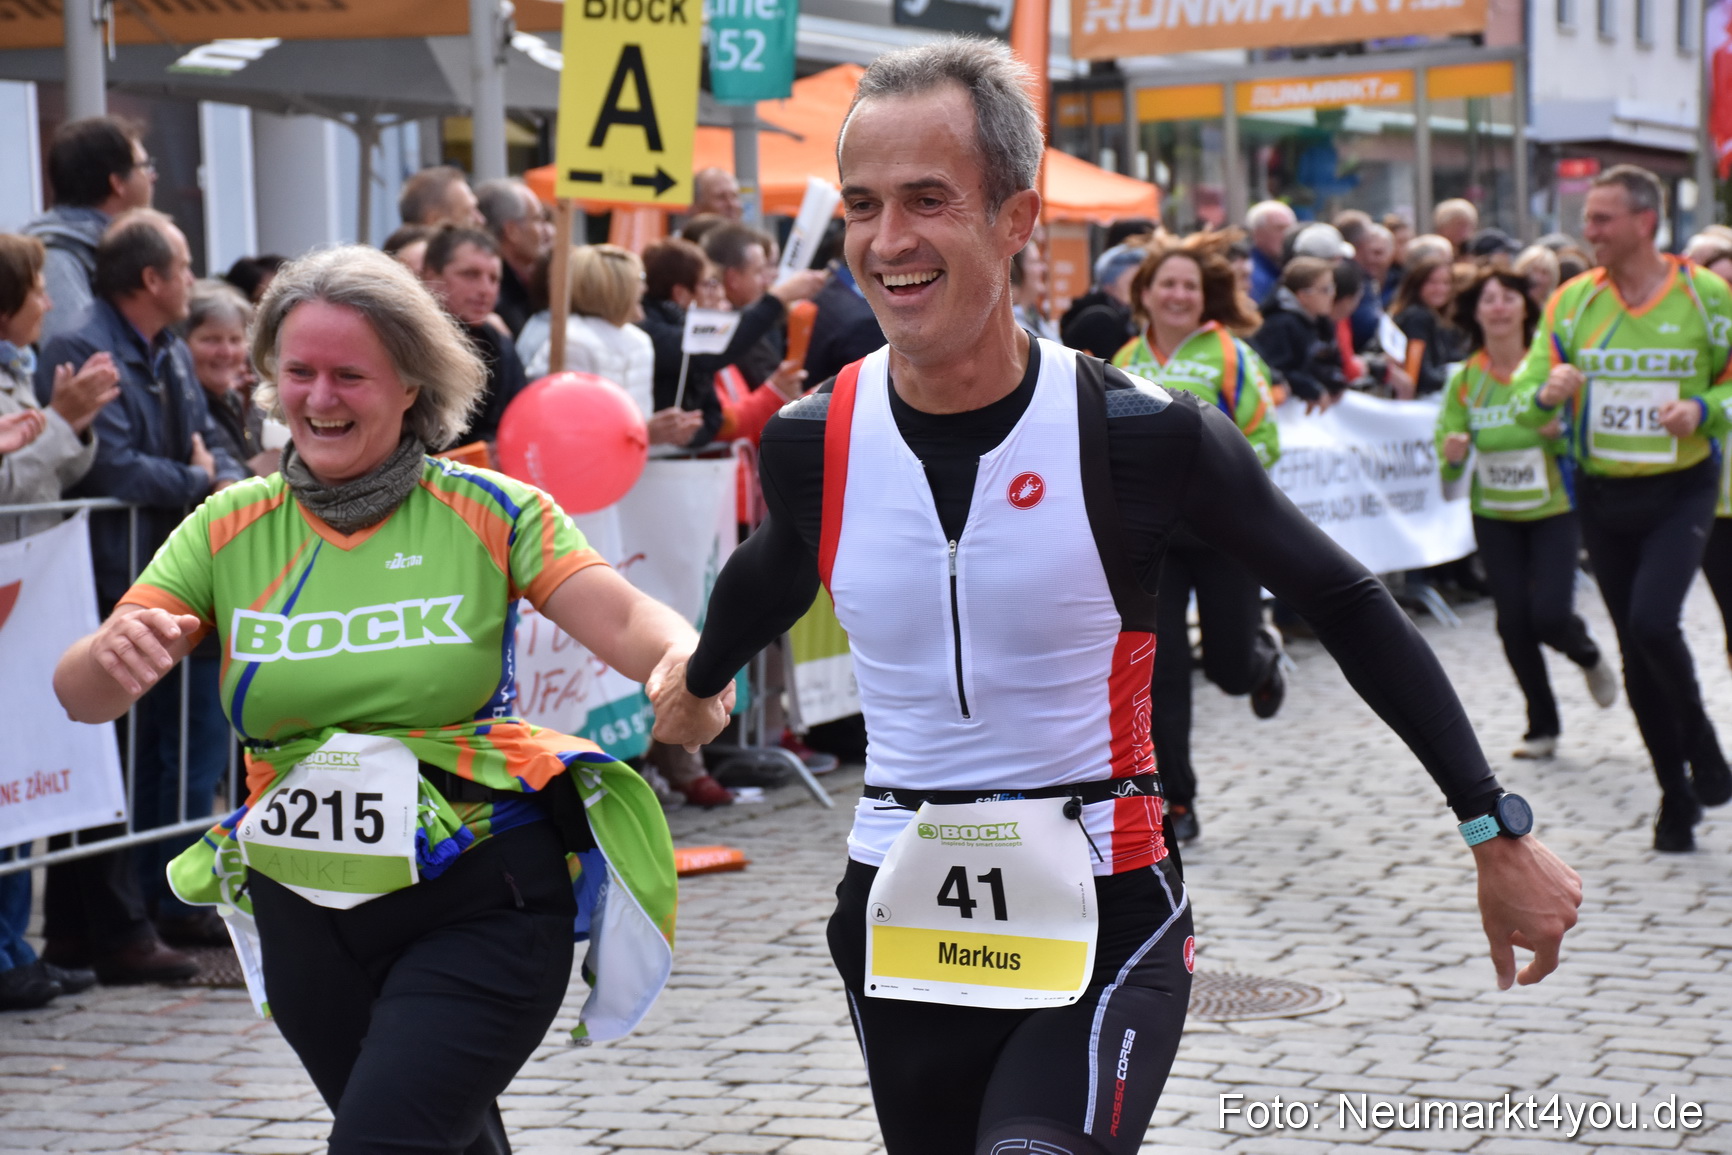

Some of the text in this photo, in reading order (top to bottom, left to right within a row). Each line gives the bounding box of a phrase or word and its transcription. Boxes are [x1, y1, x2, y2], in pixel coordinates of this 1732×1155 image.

[583, 0, 687, 24] Block
[588, 44, 664, 152] A
[1579, 348, 1697, 377] BOCK
[231, 595, 473, 663] BOCK
[25, 769, 71, 800] ZÄHLT
[261, 787, 384, 844] 5215
[939, 822, 1021, 841] BOCK
[264, 852, 364, 887] ANKE
[937, 865, 1008, 921] 41
[876, 908, 885, 918] A
[938, 942, 1021, 971] Markus
